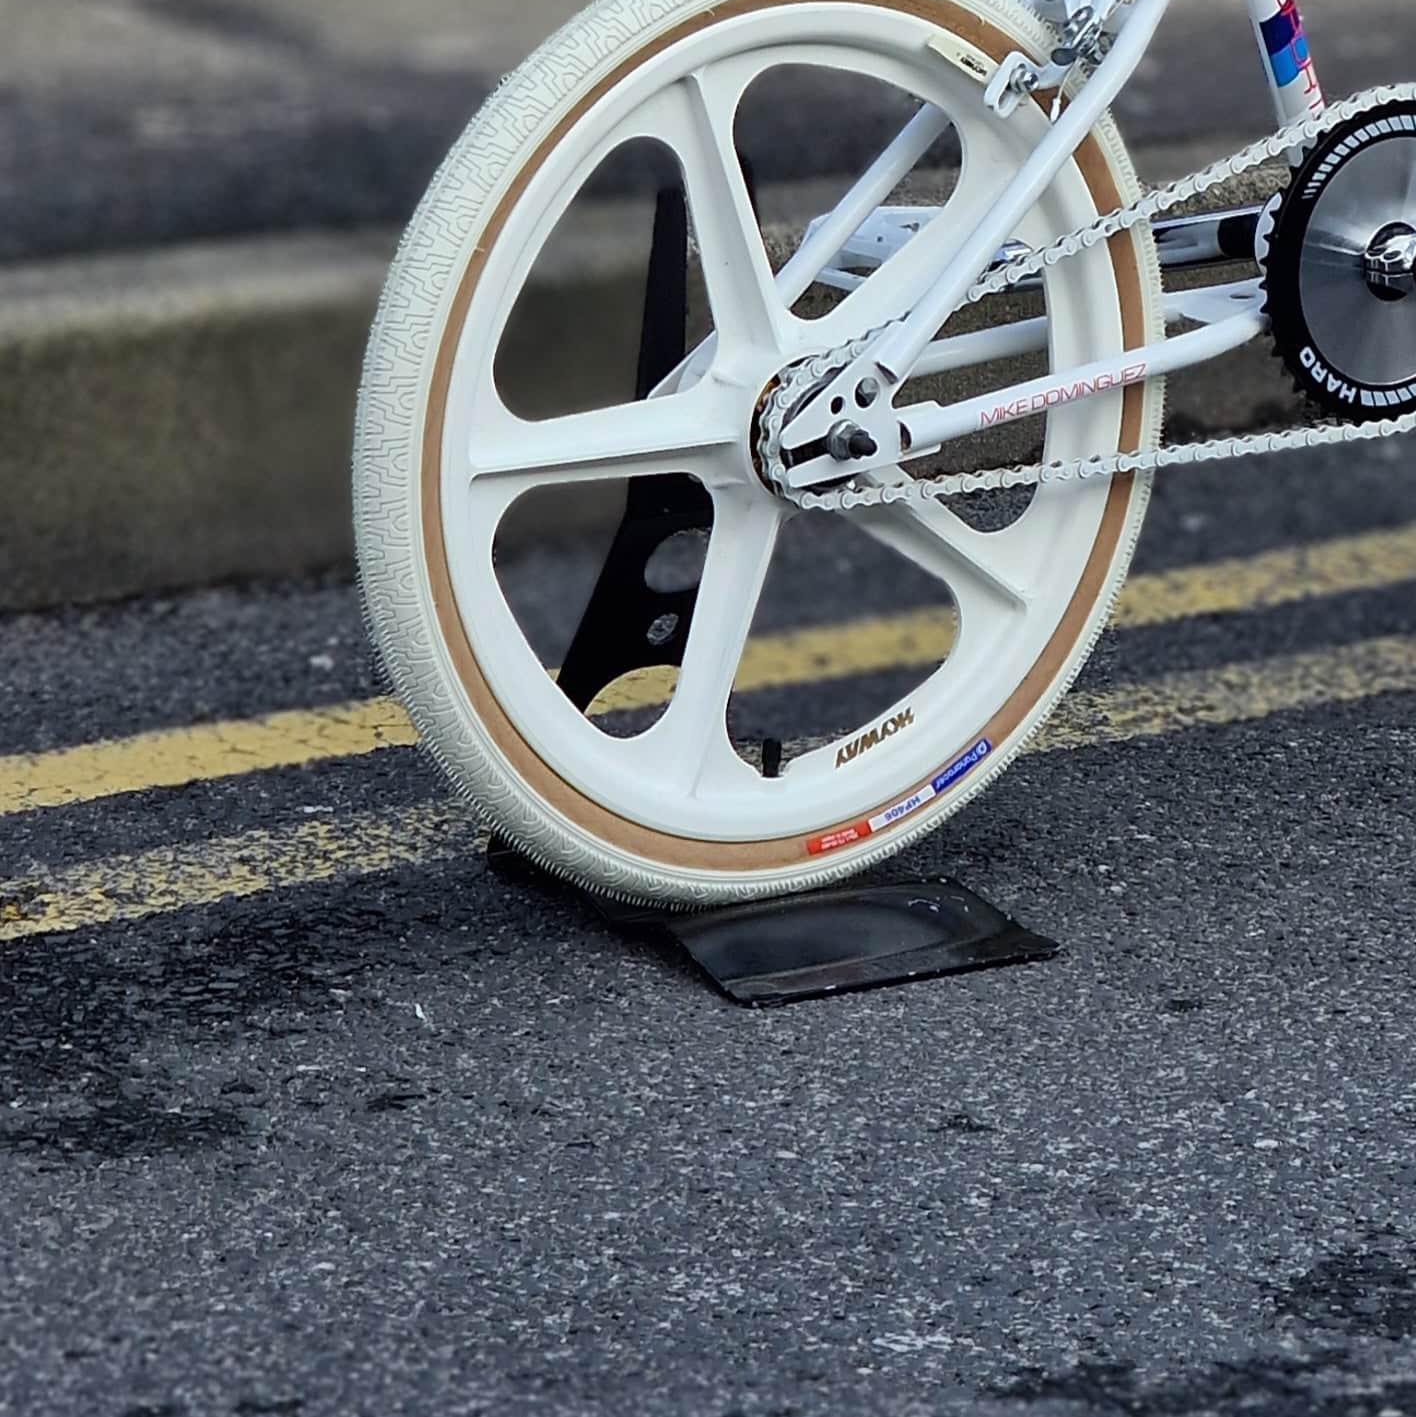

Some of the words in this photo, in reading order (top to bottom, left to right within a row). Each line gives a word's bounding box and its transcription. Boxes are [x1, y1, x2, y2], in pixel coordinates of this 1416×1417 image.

[980, 398, 1028, 425] MIKE
[1031, 363, 1147, 410] DOMINGUEZ
[1300, 346, 1357, 404] HARO
